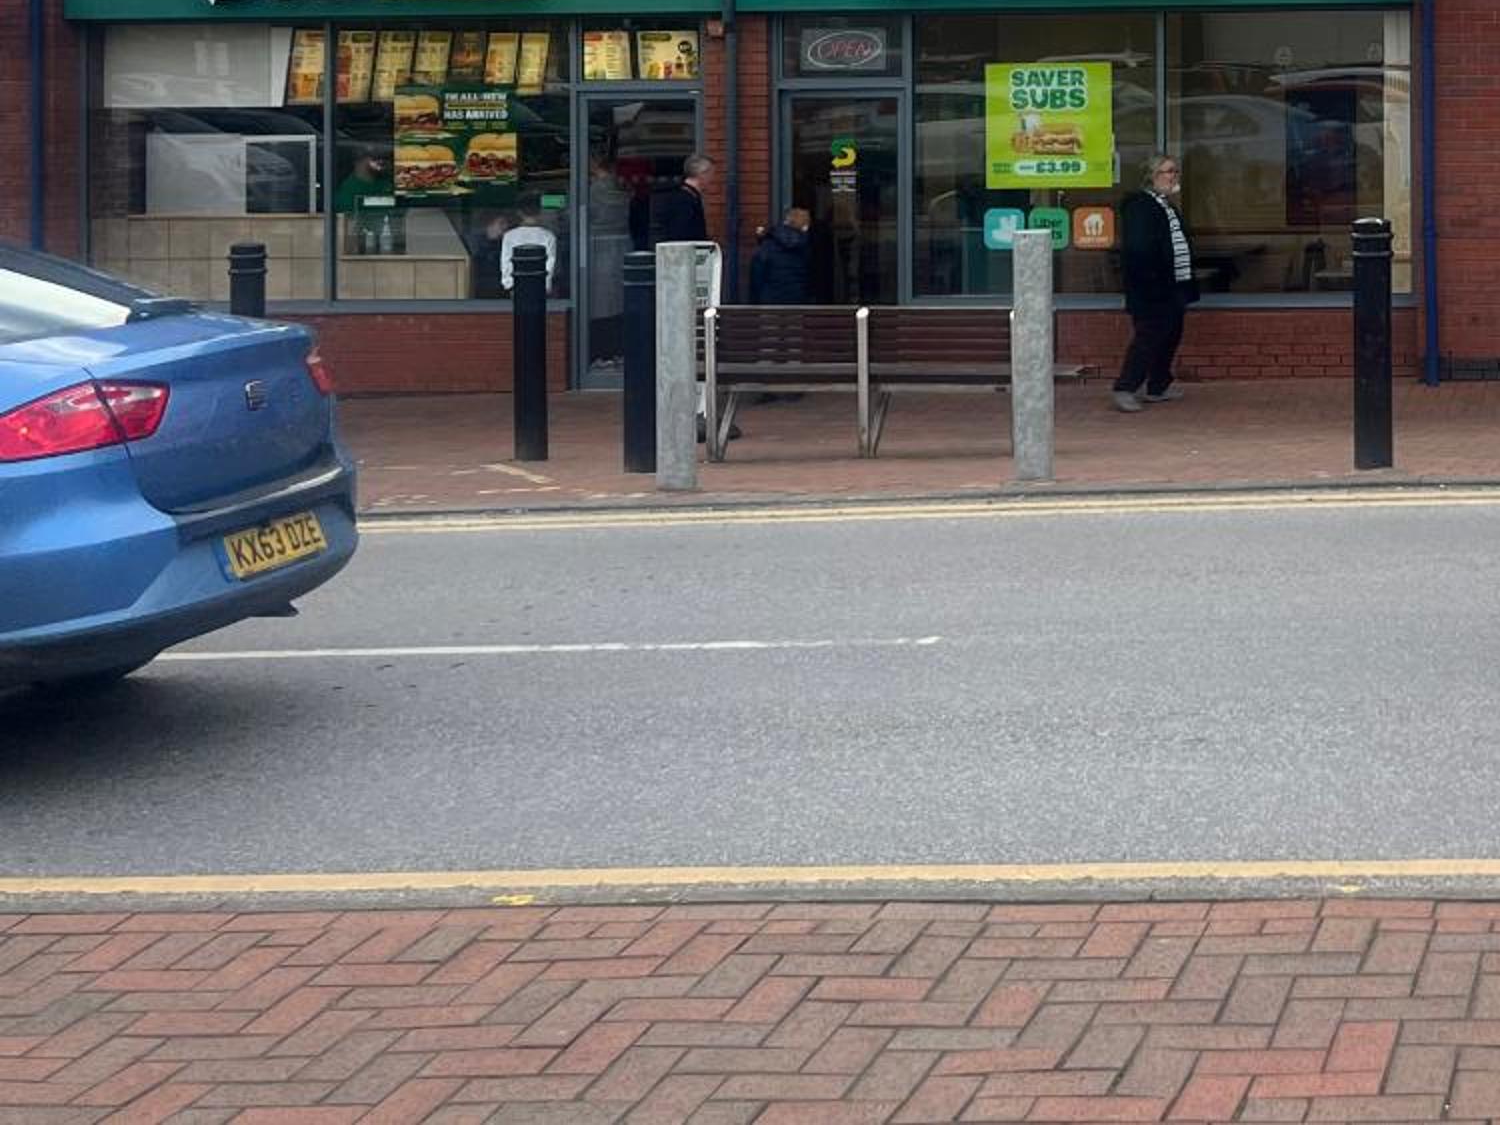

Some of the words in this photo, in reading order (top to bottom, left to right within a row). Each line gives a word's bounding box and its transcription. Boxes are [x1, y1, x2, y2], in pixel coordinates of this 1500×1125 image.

[1011, 69, 1086, 88] SAVER
[1011, 88, 1087, 110] SUBS
[231, 527, 287, 569] KX63
[284, 517, 321, 551] DZE
